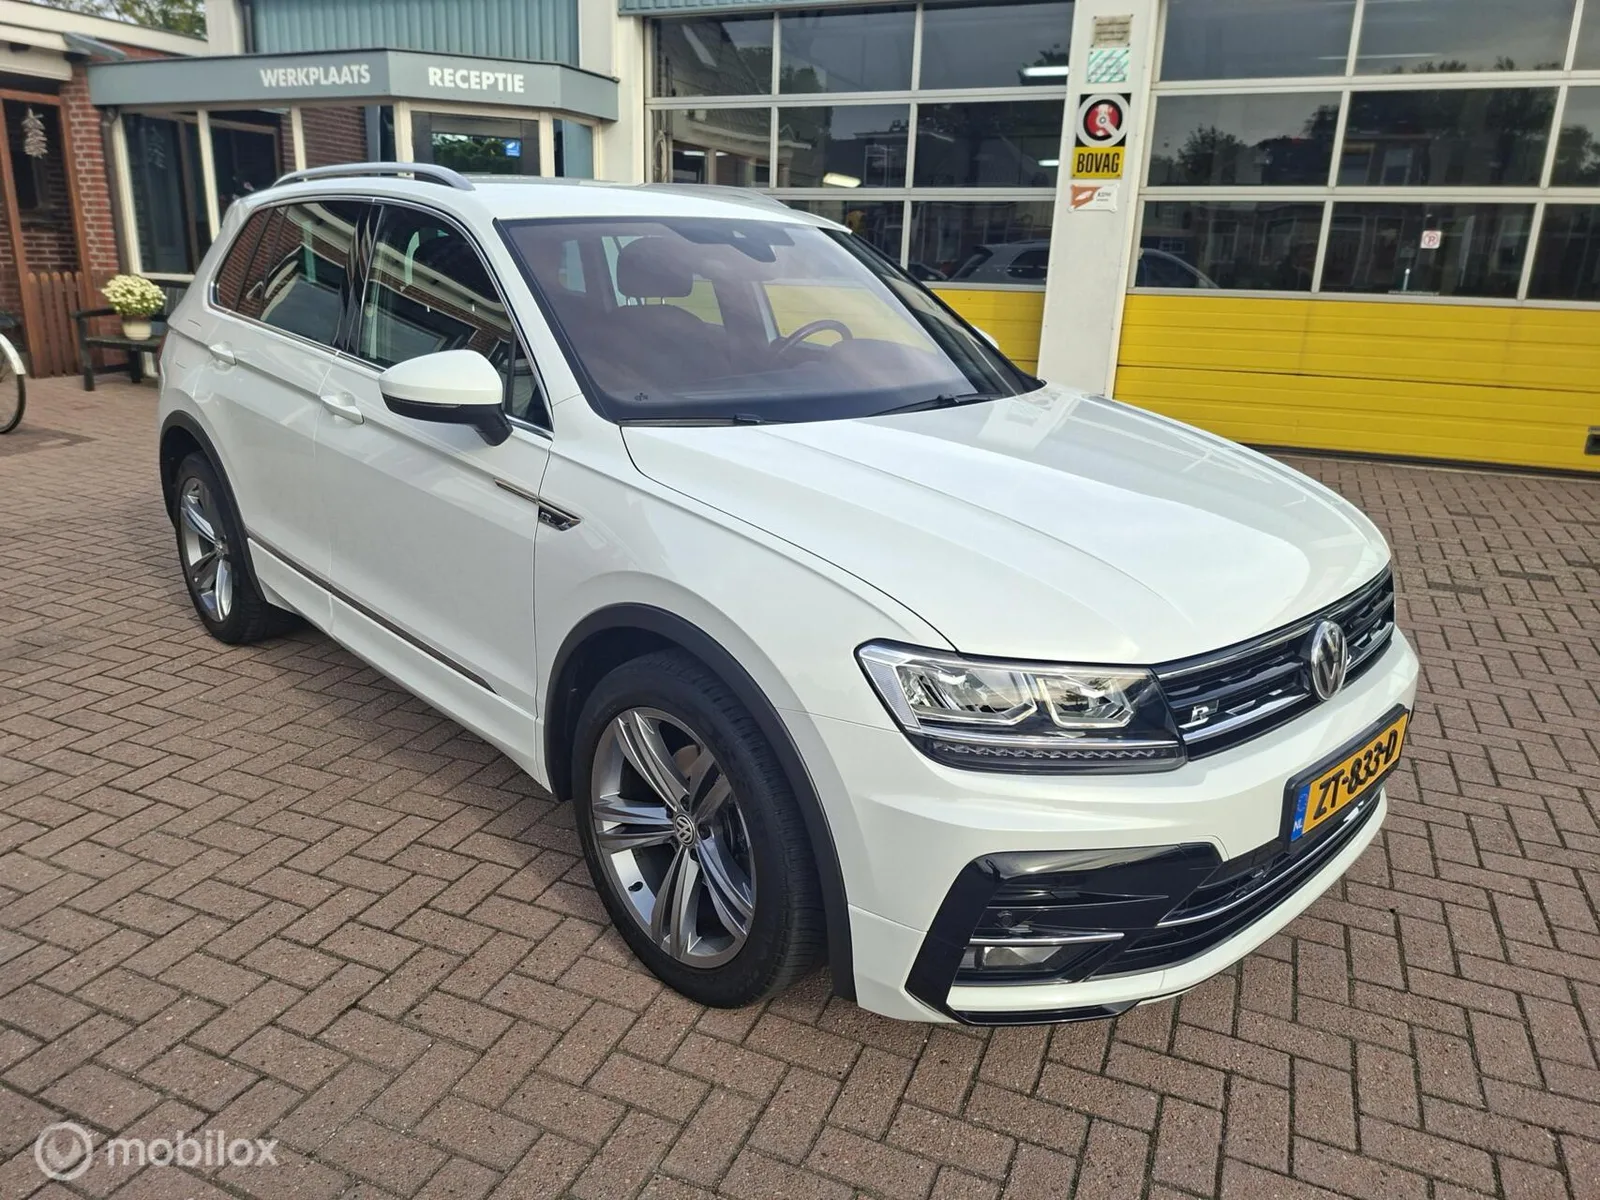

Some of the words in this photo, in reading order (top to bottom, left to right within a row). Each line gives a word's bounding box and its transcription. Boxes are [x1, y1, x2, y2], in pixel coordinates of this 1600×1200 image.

[259, 64, 371, 88] WERKPLAATS
[427, 67, 525, 93] RECEPTIE
[1076, 152, 1121, 173] BOVAG
[1313, 729, 1399, 820] ZT-833-D
[1292, 818, 1303, 832] NL
